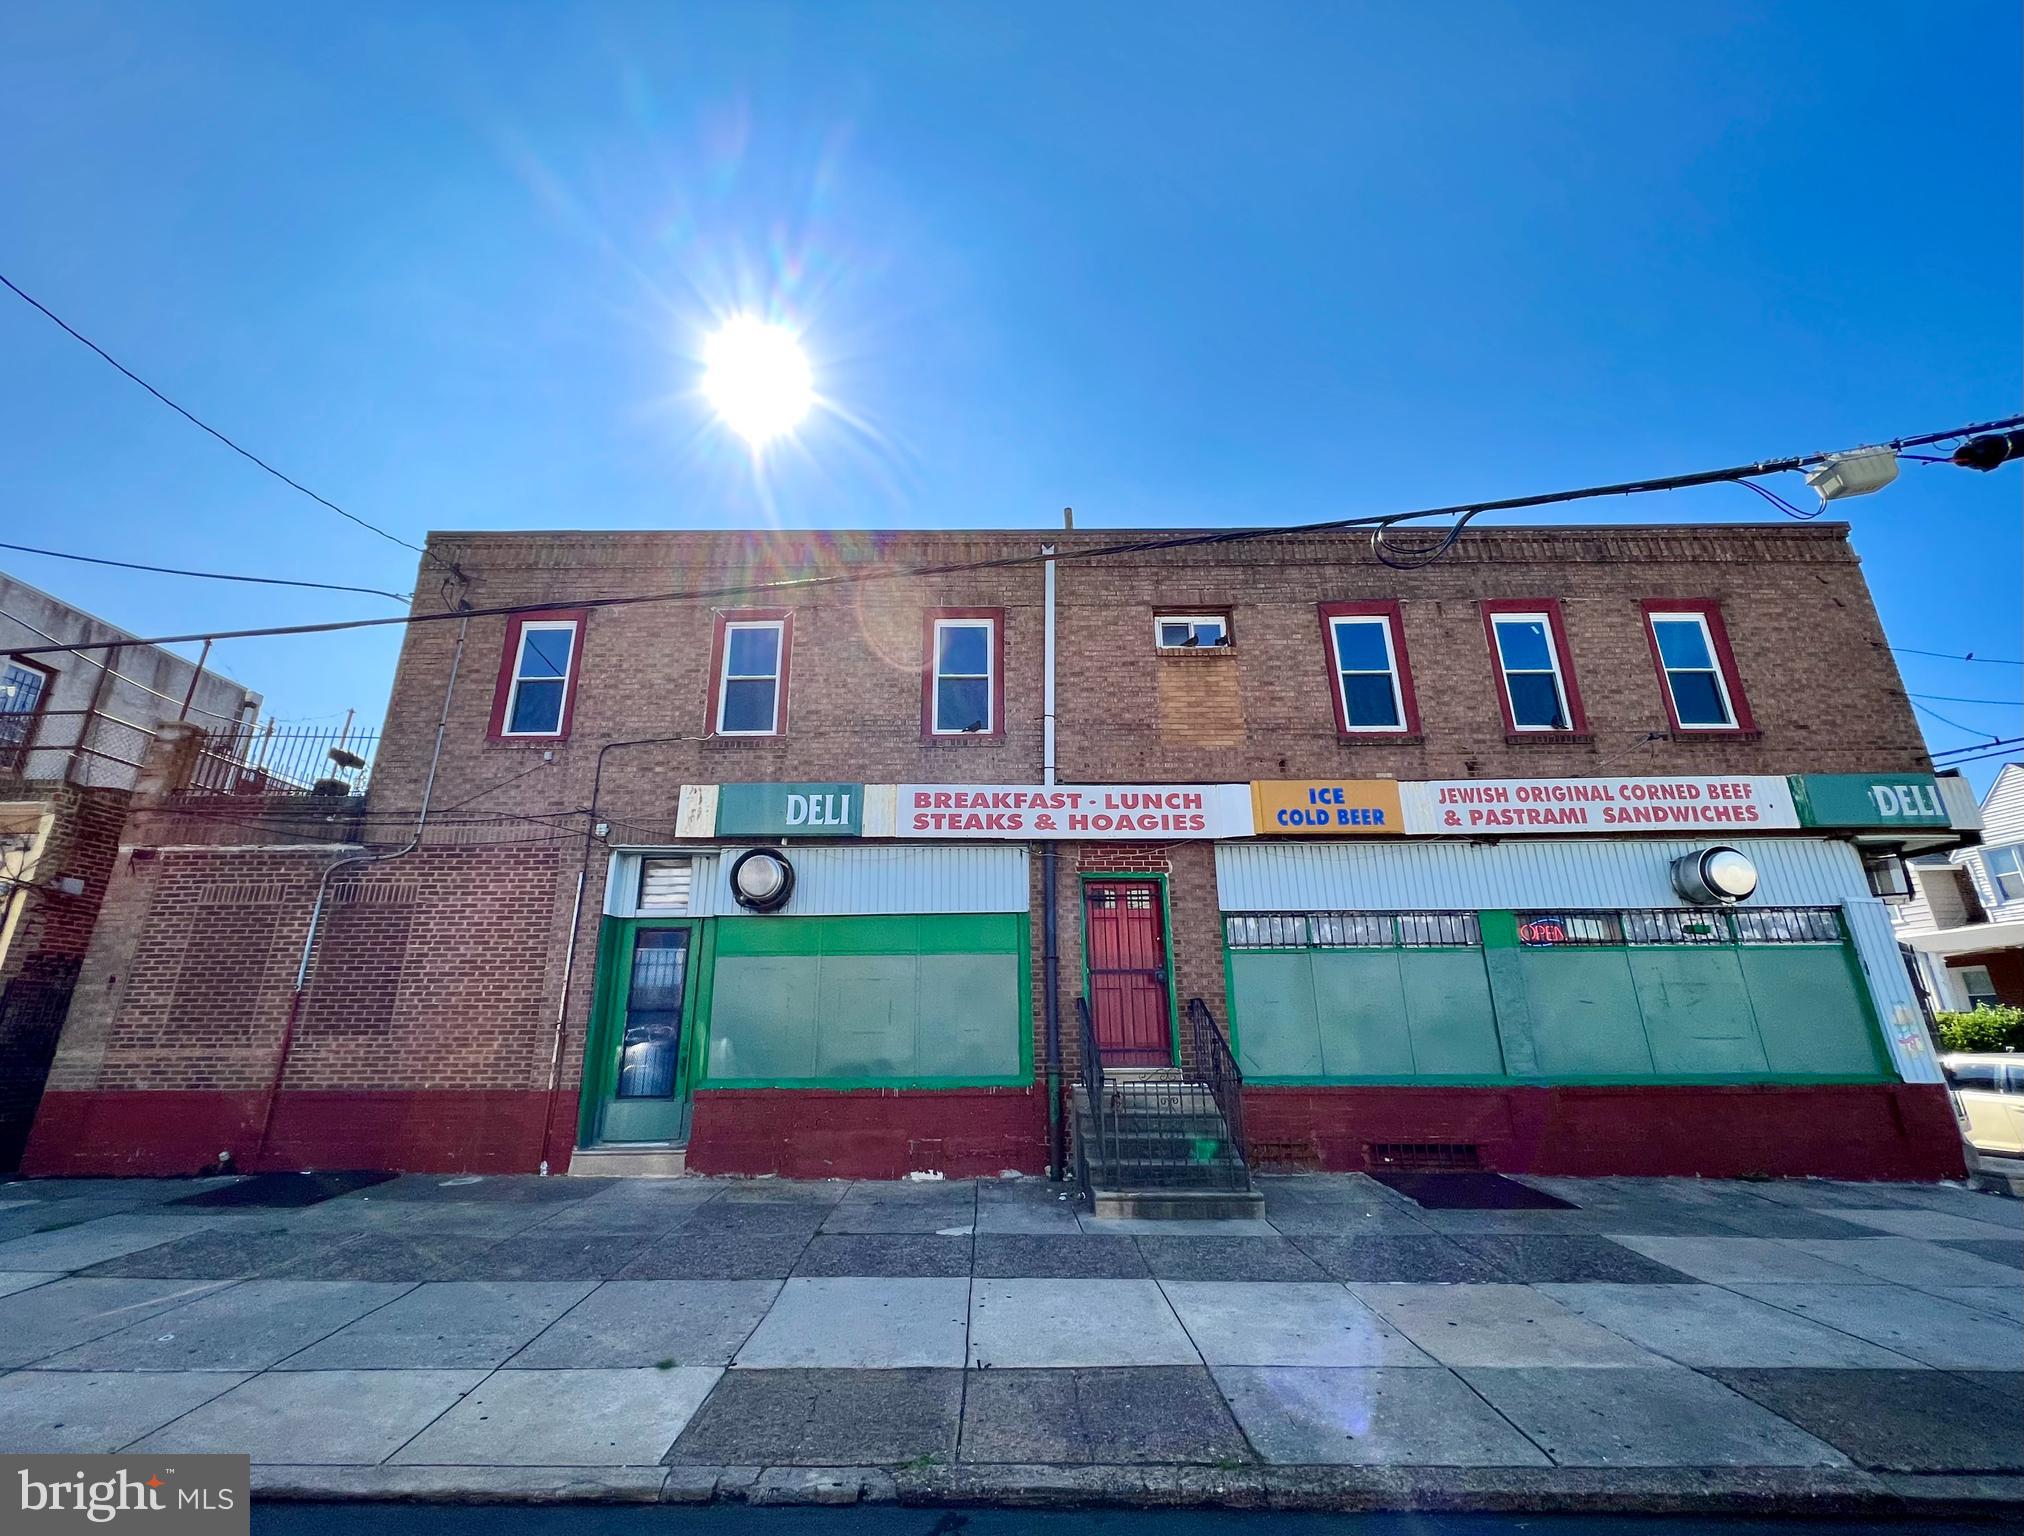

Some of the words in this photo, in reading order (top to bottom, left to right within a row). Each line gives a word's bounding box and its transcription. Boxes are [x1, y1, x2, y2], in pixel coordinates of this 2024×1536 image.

[913, 792, 1082, 810] BREAKFAST
[1105, 793, 1203, 810] LUNCH
[1308, 787, 1345, 805] ICE
[1439, 788, 1508, 804] JEWISH
[1516, 785, 1615, 802] ORIGINAL
[1619, 784, 1701, 800] CORNED
[1708, 783, 1753, 799] BEEF
[1871, 785, 1946, 816] DELI
[786, 794, 850, 825] DELI
[1277, 809, 1331, 826] COLD
[1338, 808, 1386, 826] BEER
[1444, 810, 1463, 826] &
[1470, 807, 1588, 826] PASTRAMI
[1604, 804, 1760, 824] SANDWICHES
[912, 812, 1023, 831] STEAKS
[1035, 812, 1059, 831] &
[1069, 812, 1206, 831] HOAGIES
[1520, 924, 1565, 941] OPEN
